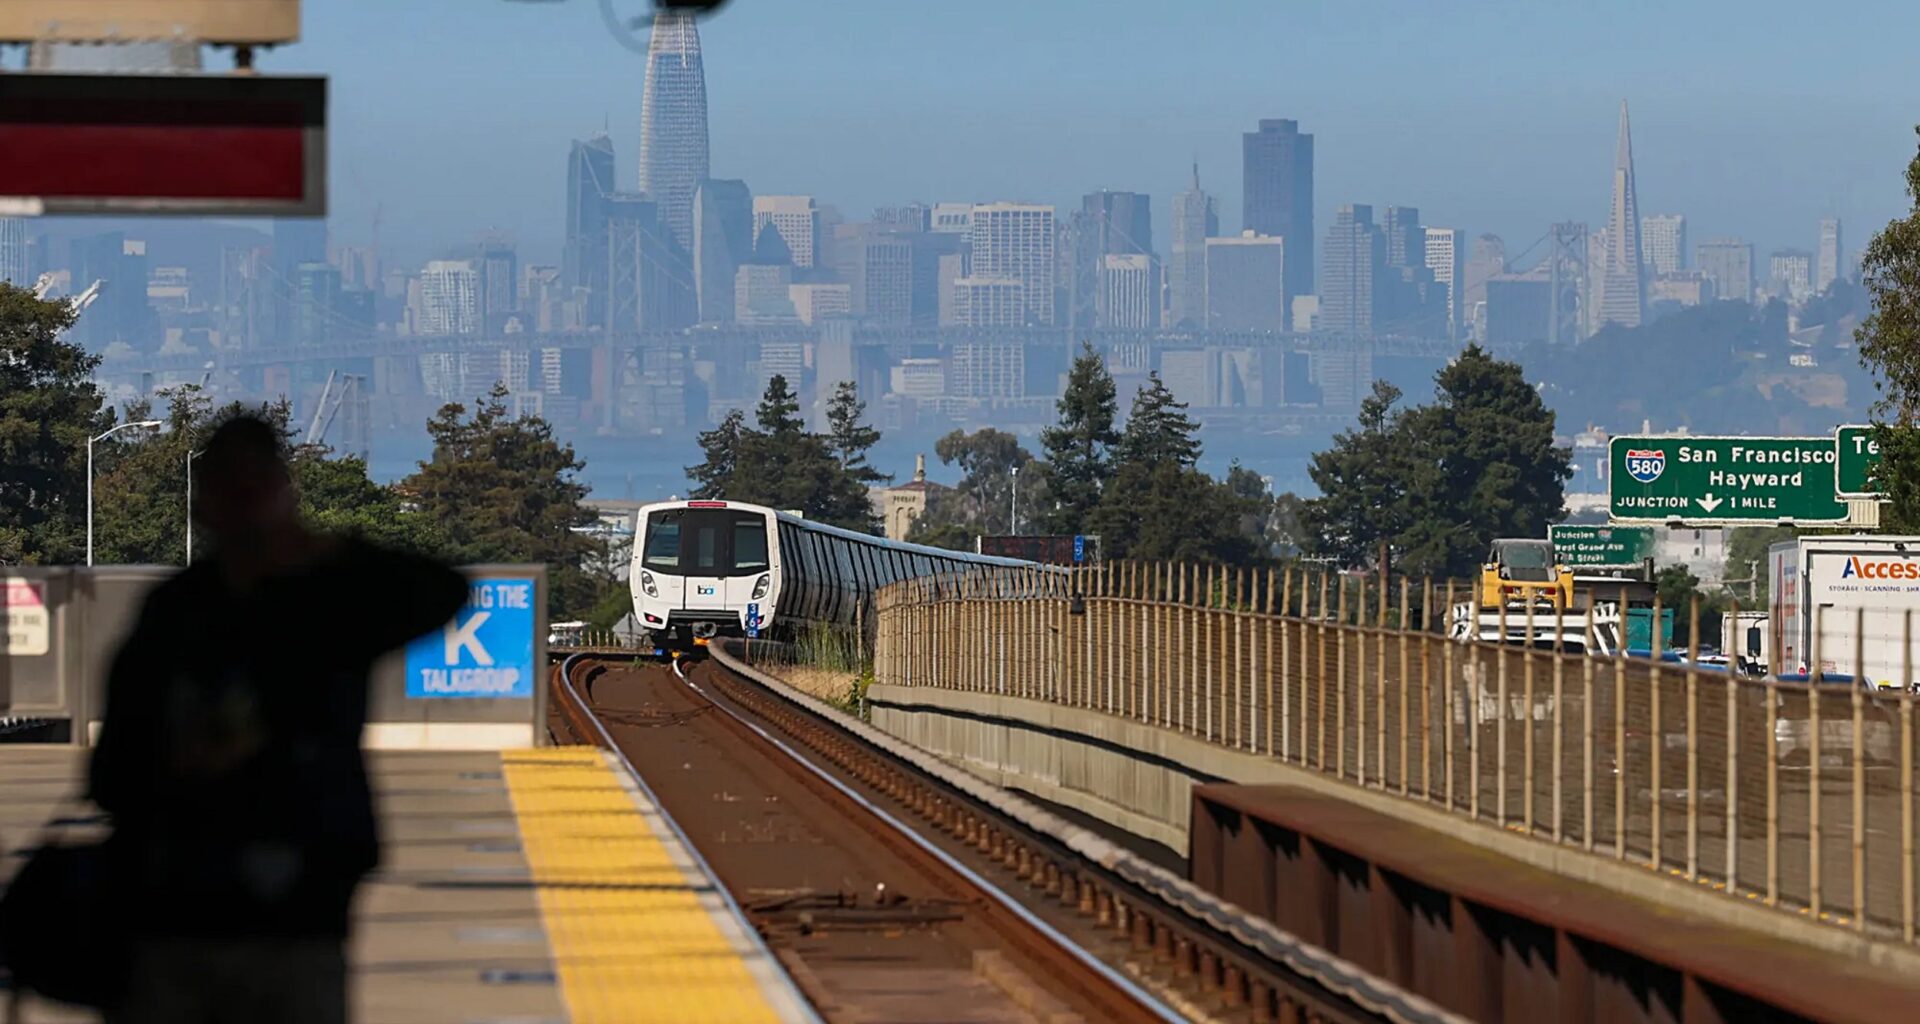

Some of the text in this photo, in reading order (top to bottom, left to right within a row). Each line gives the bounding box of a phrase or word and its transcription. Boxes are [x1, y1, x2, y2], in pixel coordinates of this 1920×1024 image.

[1852, 436, 1880, 455] Te
[1678, 446, 1836, 464] San Francisco
[1631, 459, 1661, 475] 580
[1710, 470, 1802, 490] Hayward
[1617, 496, 1776, 508] JUNCTION 1 MILE
[1554, 531, 1595, 539] Junction
[1554, 543, 1576, 551] West
[1578, 543, 1605, 551] Grand
[1577, 554, 1605, 562] Street
[497, 585, 530, 609] THE
[750, 604, 757, 614] 3
[749, 617, 756, 627] 6
[443, 611, 495, 667] K
[421, 668, 520, 693] TALKGROUP
